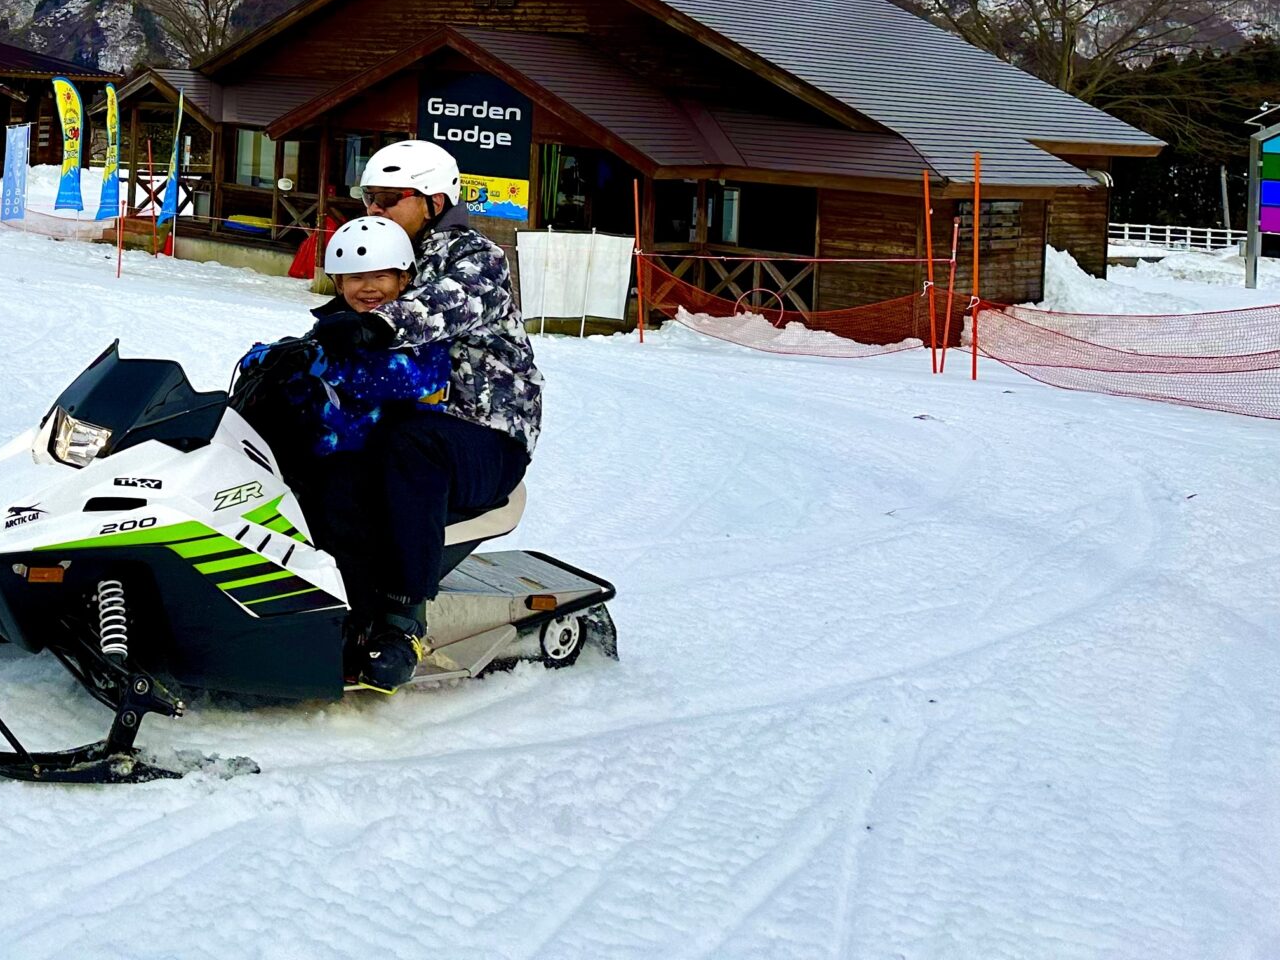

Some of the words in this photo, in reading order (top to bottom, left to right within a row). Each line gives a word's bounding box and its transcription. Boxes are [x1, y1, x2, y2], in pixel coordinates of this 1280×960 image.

[427, 97, 521, 121] Garden
[433, 122, 512, 149] Lodge
[460, 185, 488, 204] IDS
[466, 202, 487, 213] OOL
[212, 480, 264, 512] ZR
[5, 515, 27, 529] ARCTIC
[28, 512, 40, 522] CAT
[99, 517, 157, 535] 200
